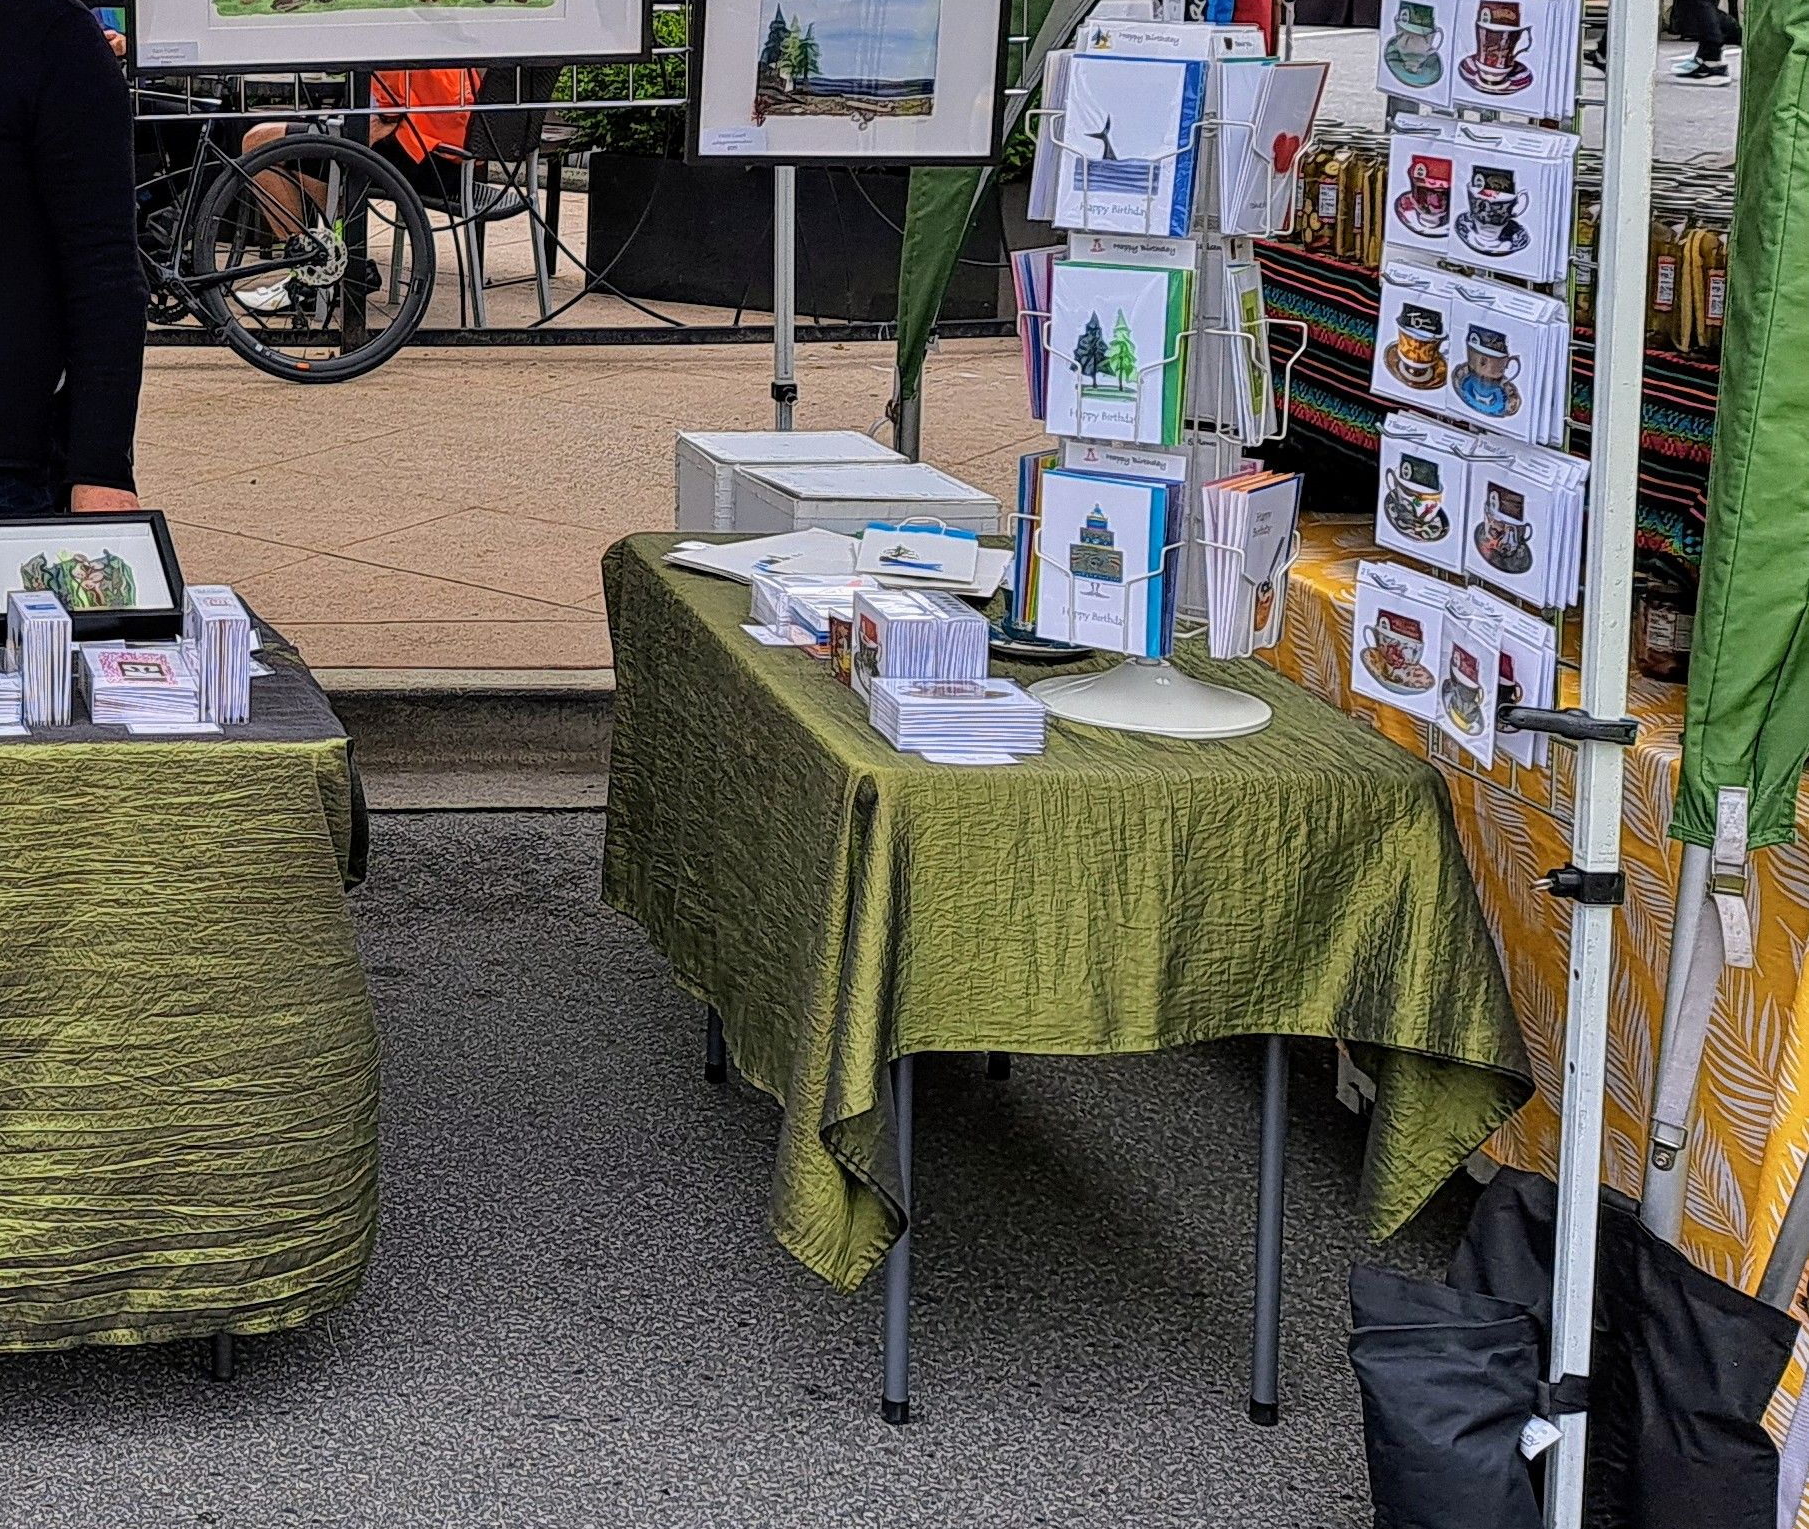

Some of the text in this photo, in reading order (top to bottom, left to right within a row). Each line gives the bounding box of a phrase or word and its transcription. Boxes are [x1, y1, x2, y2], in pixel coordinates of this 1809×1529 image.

[1118, 32, 1181, 47] Happy Birthday
[1112, 243, 1177, 257] Happy Birthday
[1105, 453, 1167, 472] Happy Birthday
